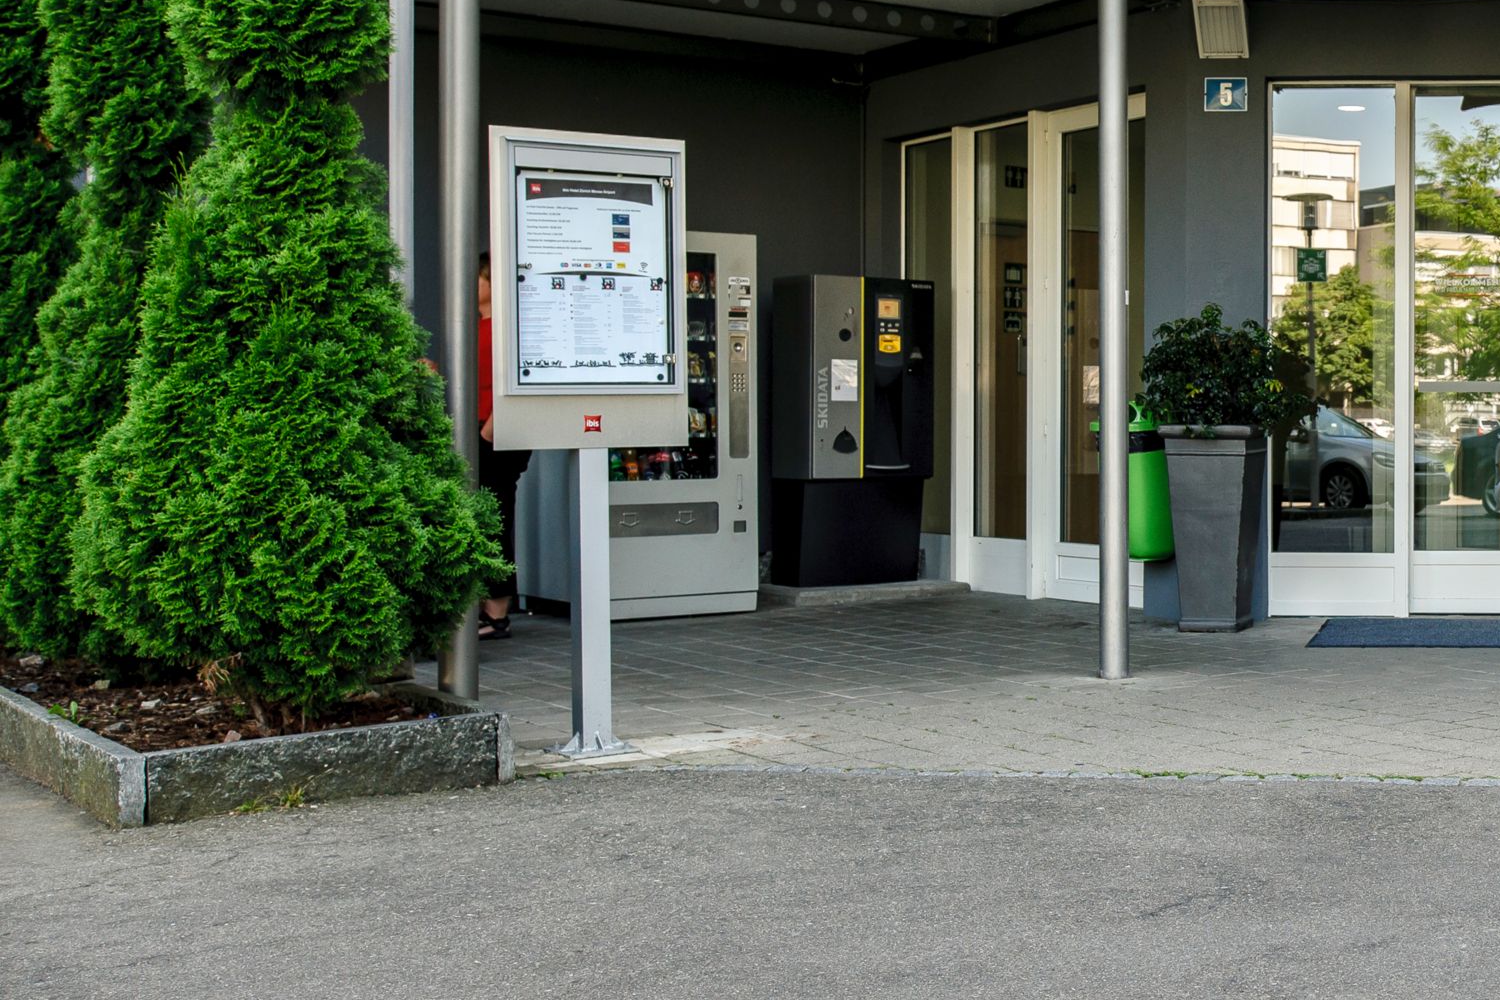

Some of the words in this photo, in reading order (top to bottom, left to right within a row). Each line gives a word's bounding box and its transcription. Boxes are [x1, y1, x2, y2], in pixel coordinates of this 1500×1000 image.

[1219, 82, 1233, 107] 5
[817, 366, 829, 429] SKIDATA
[586, 419, 599, 427] ibis
